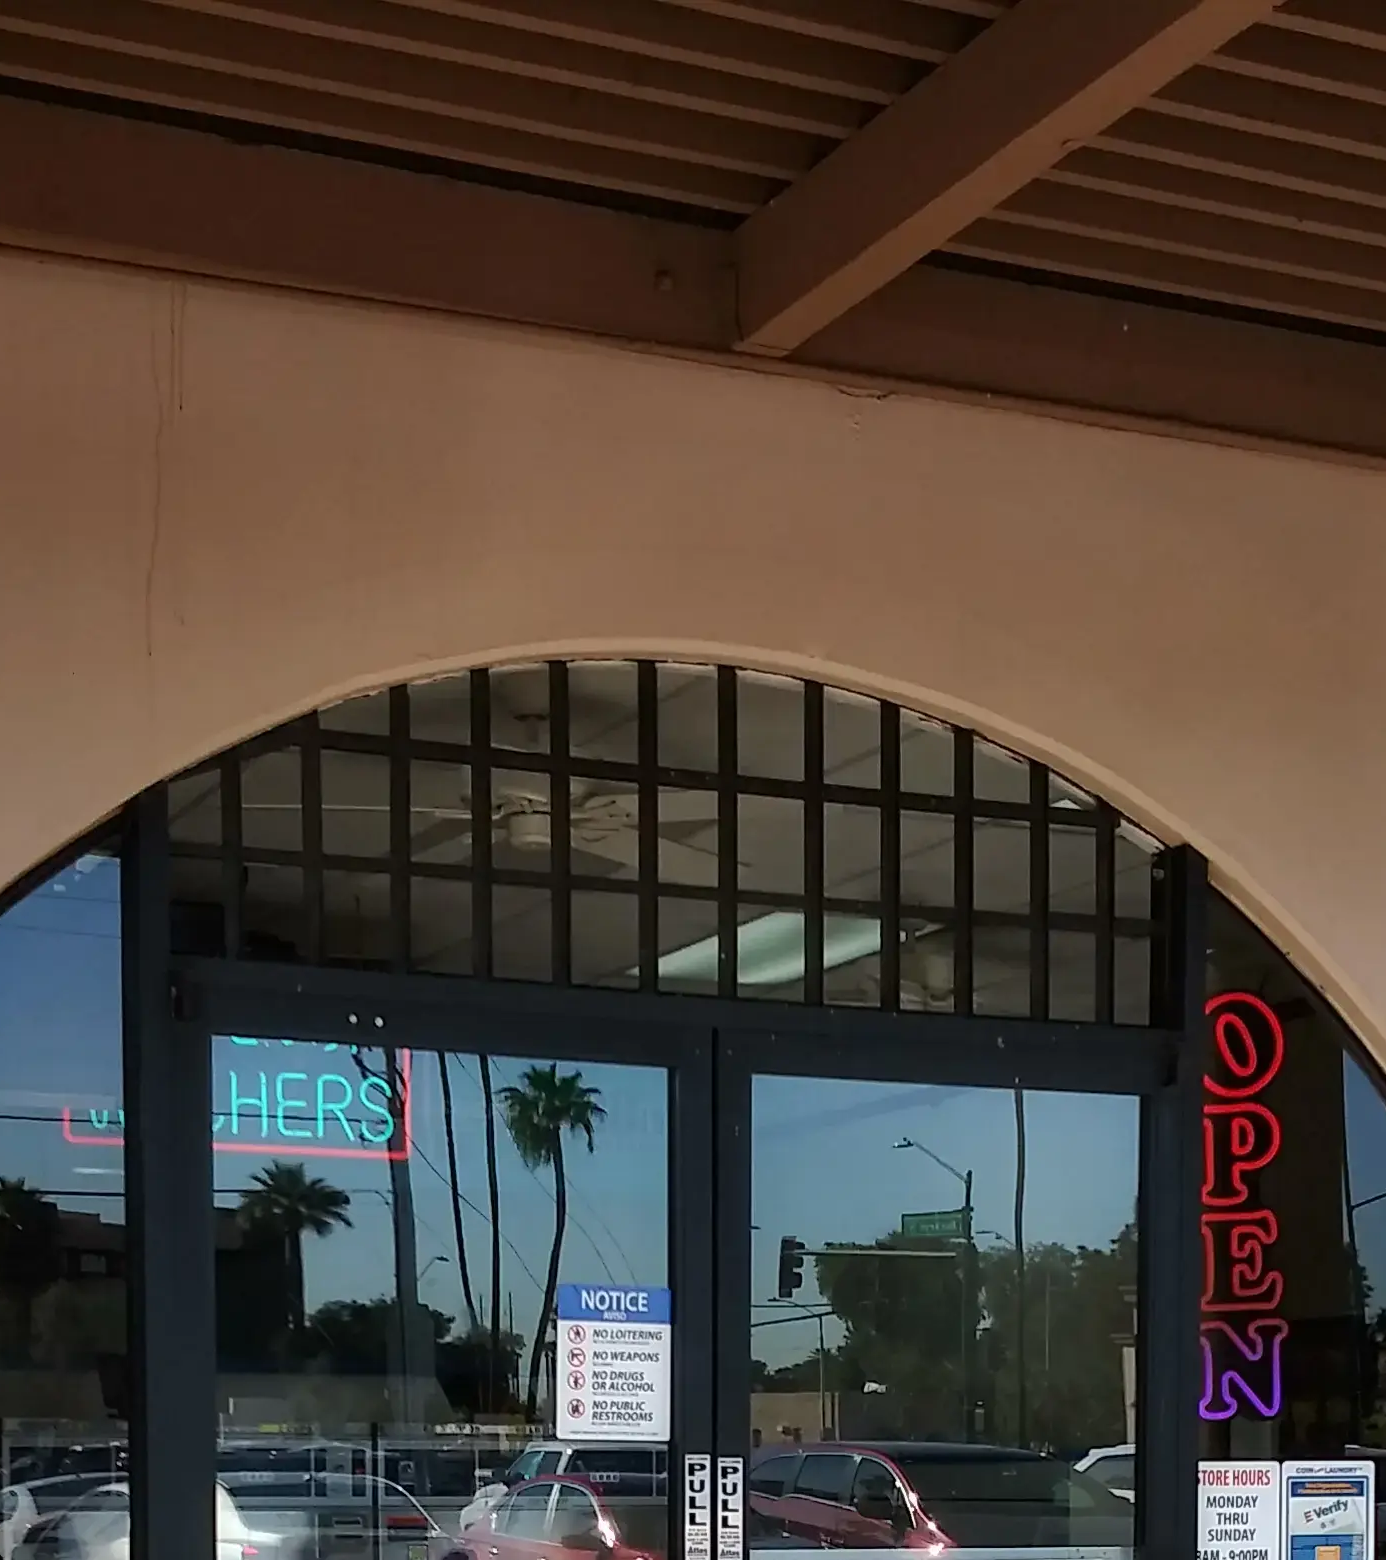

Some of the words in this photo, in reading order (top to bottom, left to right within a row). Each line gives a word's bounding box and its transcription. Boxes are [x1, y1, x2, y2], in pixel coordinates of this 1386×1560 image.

[213, 1070, 394, 1144] HERS
[1199, 992, 1289, 1420] OPEN
[581, 1289, 649, 1312] NOTICE
[593, 1329, 609, 1339] NO
[610, 1330, 663, 1341] LOITERING
[592, 1351, 609, 1361] NO
[610, 1351, 660, 1363] WEAPONS
[592, 1370, 608, 1381] NO
[609, 1371, 645, 1382] DRUGS
[592, 1382, 608, 1392] OR
[608, 1382, 655, 1393] ALCOHOL
[592, 1400, 608, 1411] NO
[609, 1402, 646, 1412] PUBLIC
[592, 1411, 654, 1422] RESTROOMS
[1232, 1469, 1271, 1486] HOURS
[687, 1462, 708, 1527] PULL
[720, 1465, 740, 1529] PULL
[1205, 1495, 1259, 1509] MONDAY
[1312, 1499, 1349, 1520] Verify
[1215, 1512, 1249, 1526] THRU
[1207, 1528, 1257, 1543] SUNDAY
